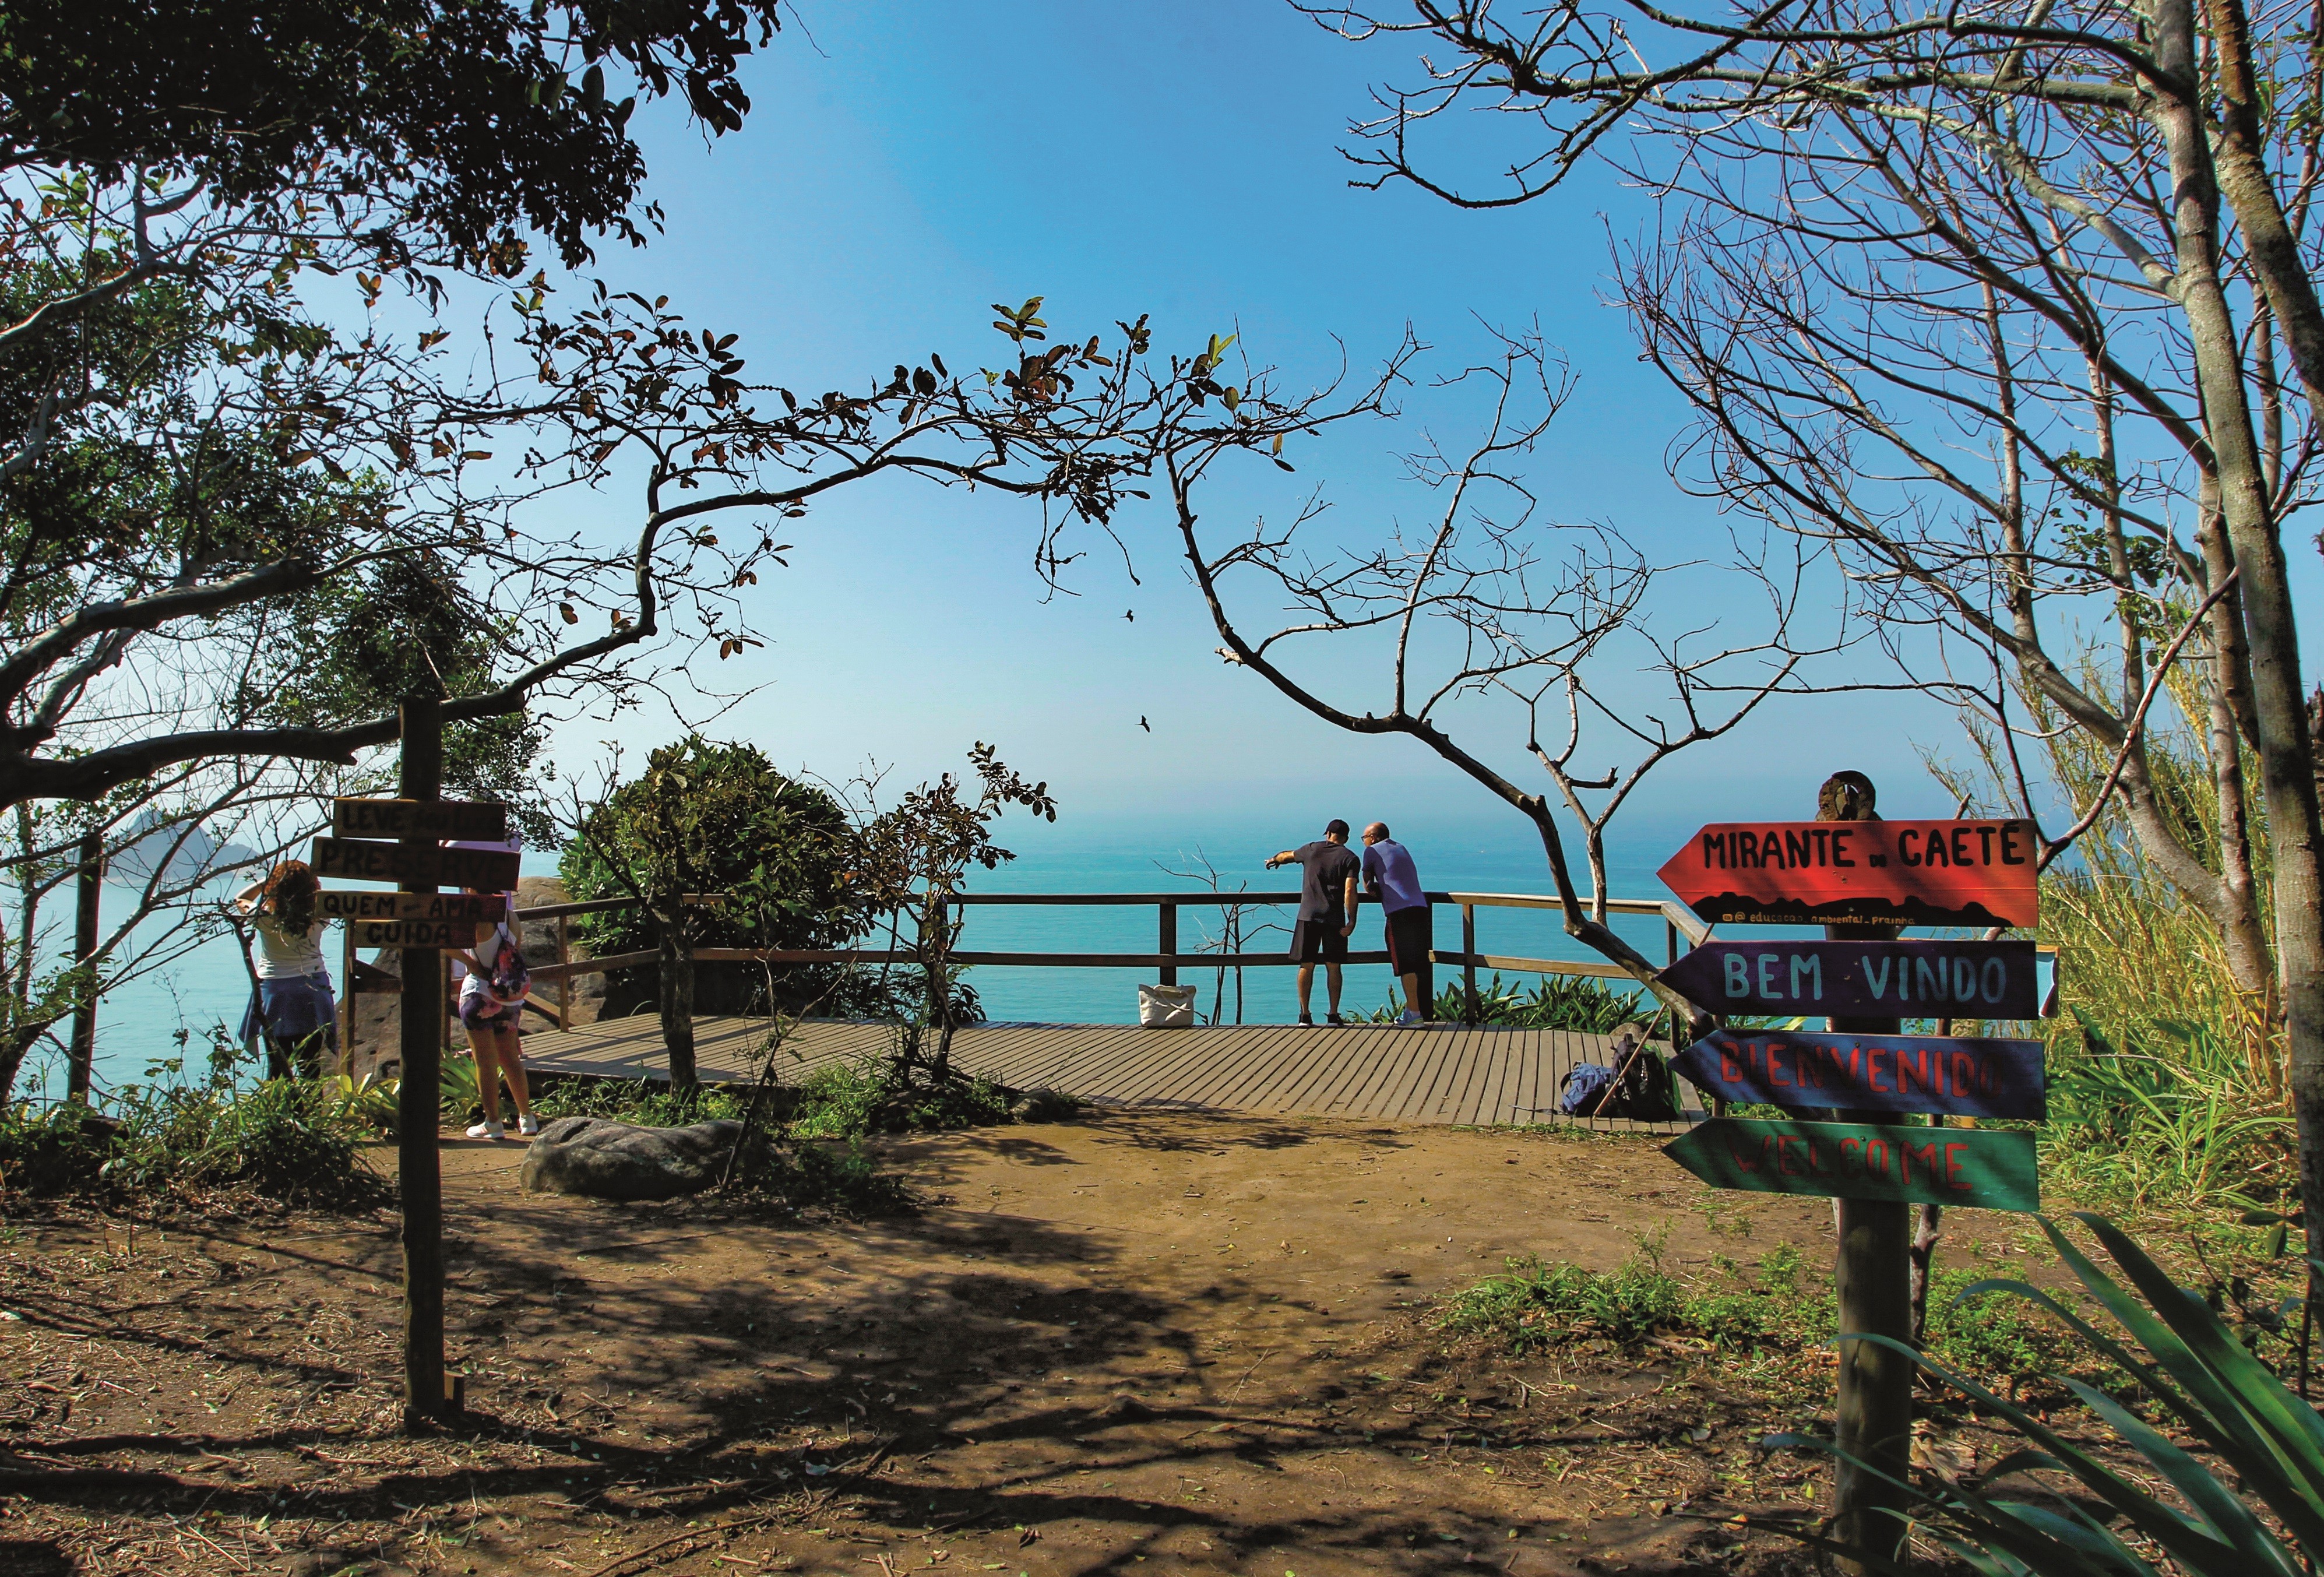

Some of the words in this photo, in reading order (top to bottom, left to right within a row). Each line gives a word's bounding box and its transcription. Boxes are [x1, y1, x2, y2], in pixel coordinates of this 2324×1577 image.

[341, 804, 405, 831] LEVE
[320, 841, 506, 884] PRESERVE
[1703, 828, 1855, 870] MIRANTE
[1899, 819, 2025, 868] CAETÉ
[323, 895, 396, 917] QUEM
[429, 897, 483, 918] AMA
[367, 923, 452, 944] CUIDA
[1724, 953, 1822, 1000] BEM
[1862, 956, 2007, 1004] VINDO
[1720, 1041, 2003, 1099] BIENVENIDO
[1726, 1134, 1973, 1190] WELCOME
